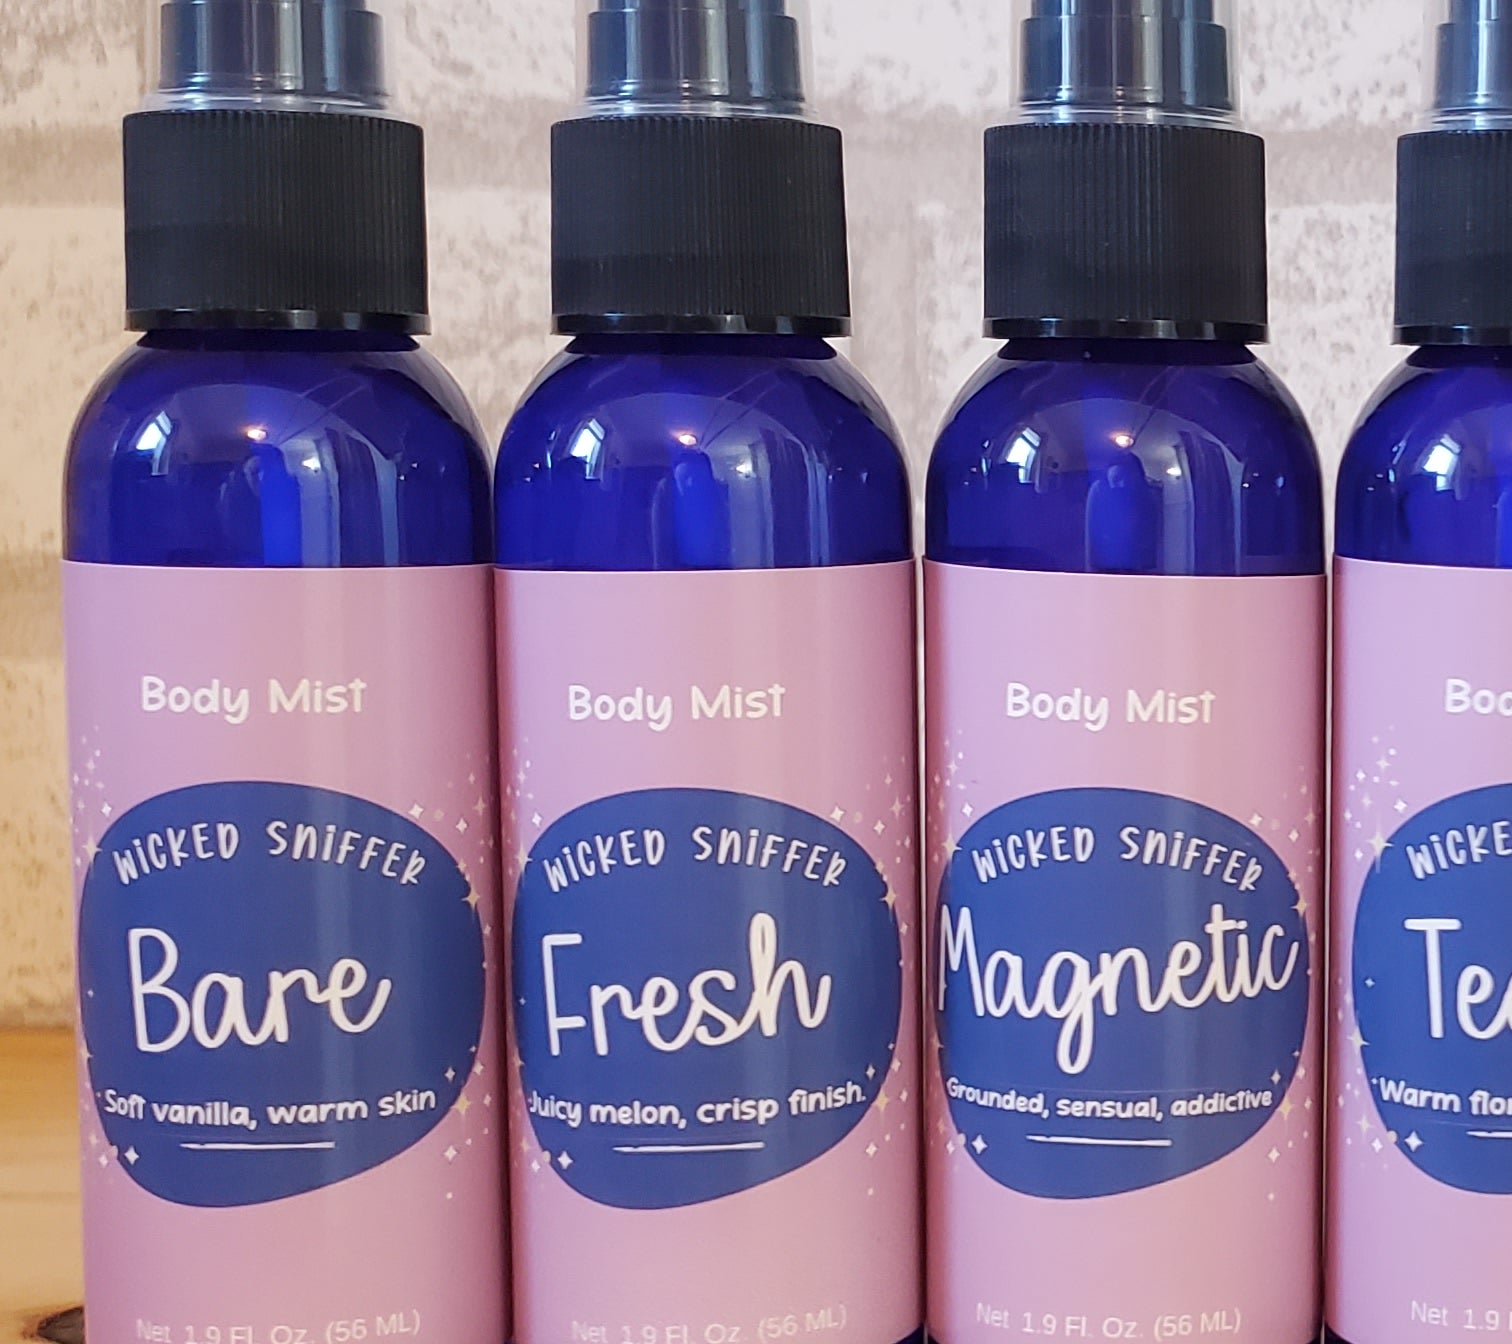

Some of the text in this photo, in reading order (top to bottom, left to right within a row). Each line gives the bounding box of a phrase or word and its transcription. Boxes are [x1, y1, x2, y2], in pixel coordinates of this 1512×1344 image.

[142, 676, 366, 724] Body Mist
[569, 684, 785, 731] Body Mist
[1007, 683, 1215, 731] Body Mist
[129, 929, 391, 1052] Bare
[543, 913, 831, 1055] Fresh
[940, 902, 1300, 1075] Magnetic
[105, 1090, 435, 1130] Soft vanilla, warm skin
[528, 1082, 868, 1128] Juicy melon, crisp finish.
[948, 1078, 1272, 1121] Grounded, sensual, addictive
[1380, 1078, 1460, 1112] Warm
[136, 1319, 171, 1343] Net
[376, 1309, 420, 1336] ML)
[572, 1321, 608, 1343] Net
[758, 1315, 798, 1344] (56
[806, 1305, 846, 1331] ML)
[977, 1303, 1009, 1328] Net
[1022, 1312, 1056, 1335] 1.9
[1154, 1315, 1192, 1341] (56
[1201, 1308, 1241, 1333] ML)
[1412, 1300, 1448, 1326] Net
[1464, 1309, 1499, 1330] 1.9
